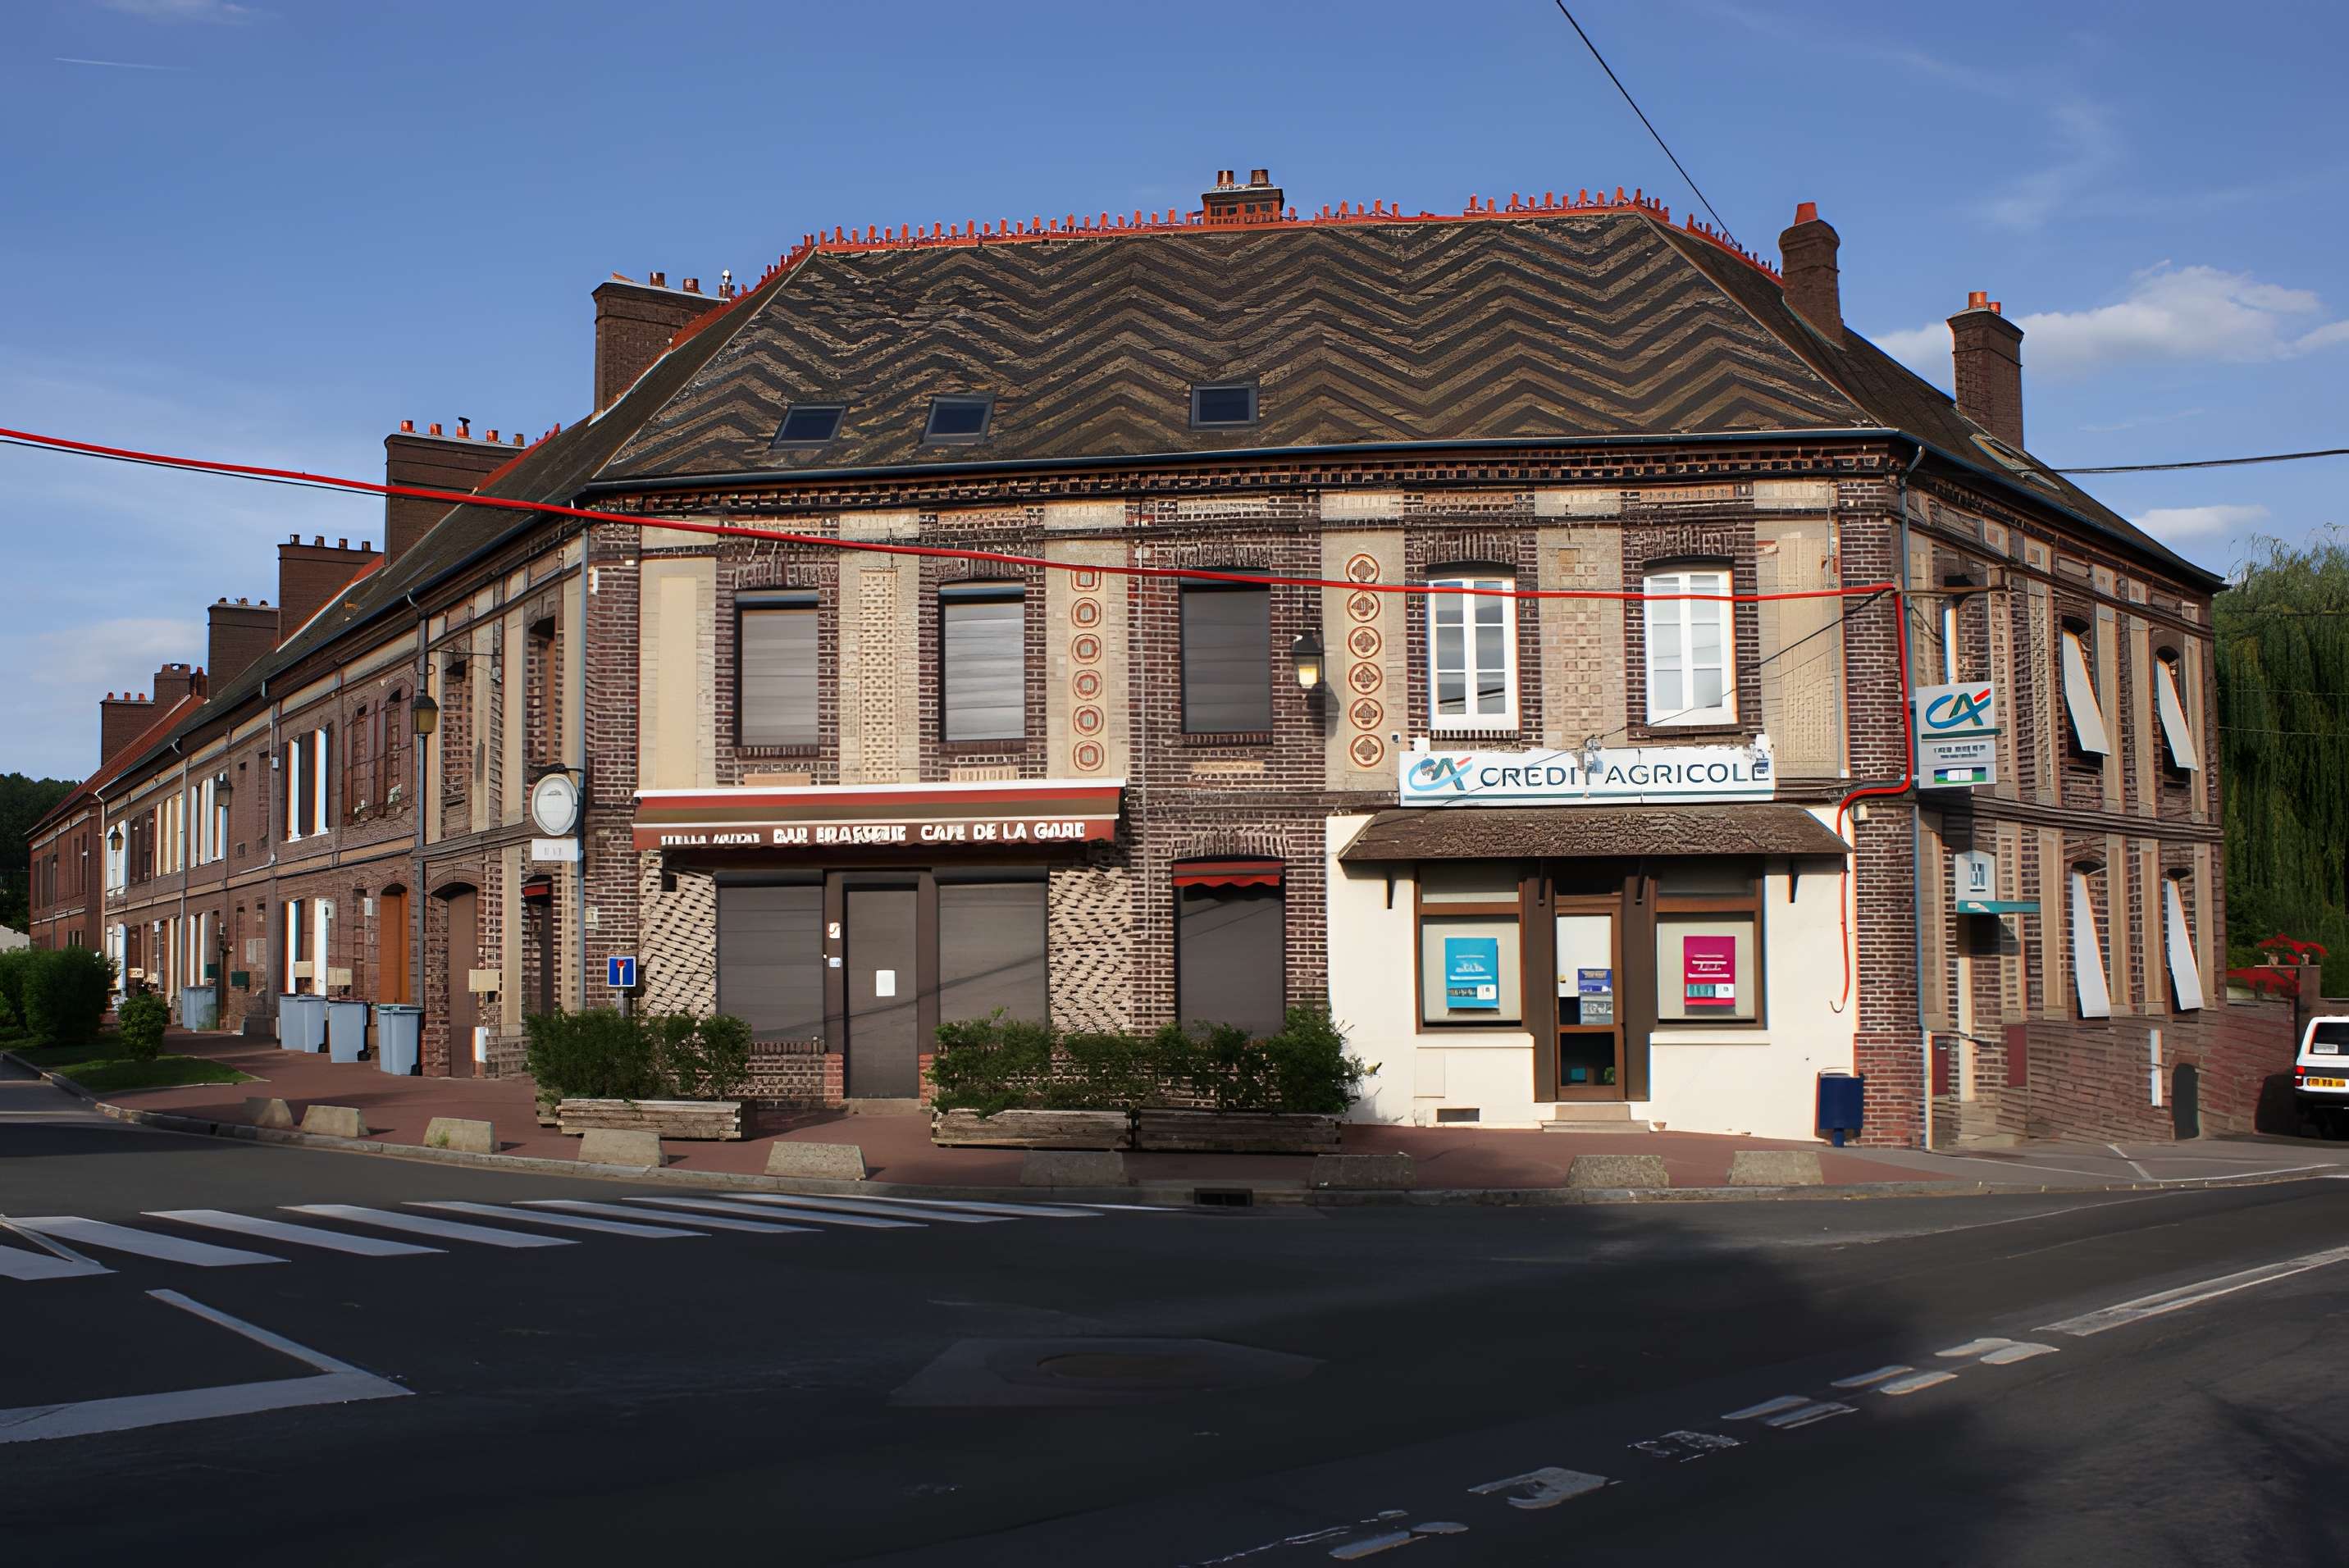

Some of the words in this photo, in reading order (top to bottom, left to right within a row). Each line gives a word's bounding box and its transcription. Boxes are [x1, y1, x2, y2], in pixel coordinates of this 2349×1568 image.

[1604, 762, 1770, 785] AGRICOLE
[973, 823, 997, 840] DE
[1002, 822, 1027, 839] LA
